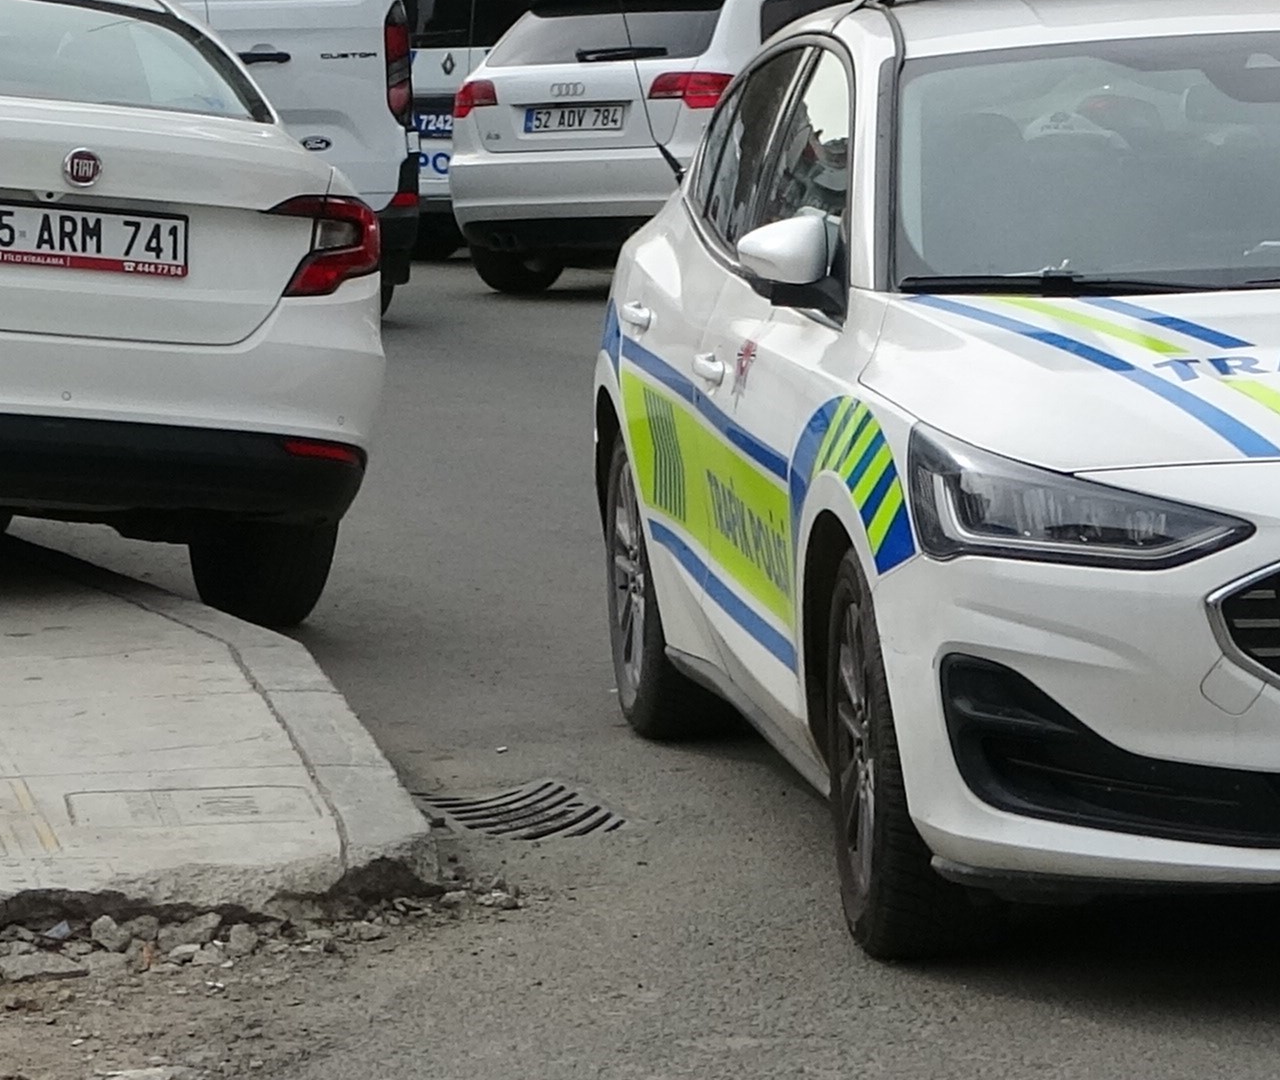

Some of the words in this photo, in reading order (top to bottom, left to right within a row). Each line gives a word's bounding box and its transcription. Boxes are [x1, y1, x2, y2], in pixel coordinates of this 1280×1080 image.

[419, 114, 453, 130] 7242
[534, 111, 552, 129] 52
[592, 108, 619, 126] 784
[72, 157, 97, 178] FIAT
[35, 213, 102, 254] ARM
[122, 220, 179, 261] 741
